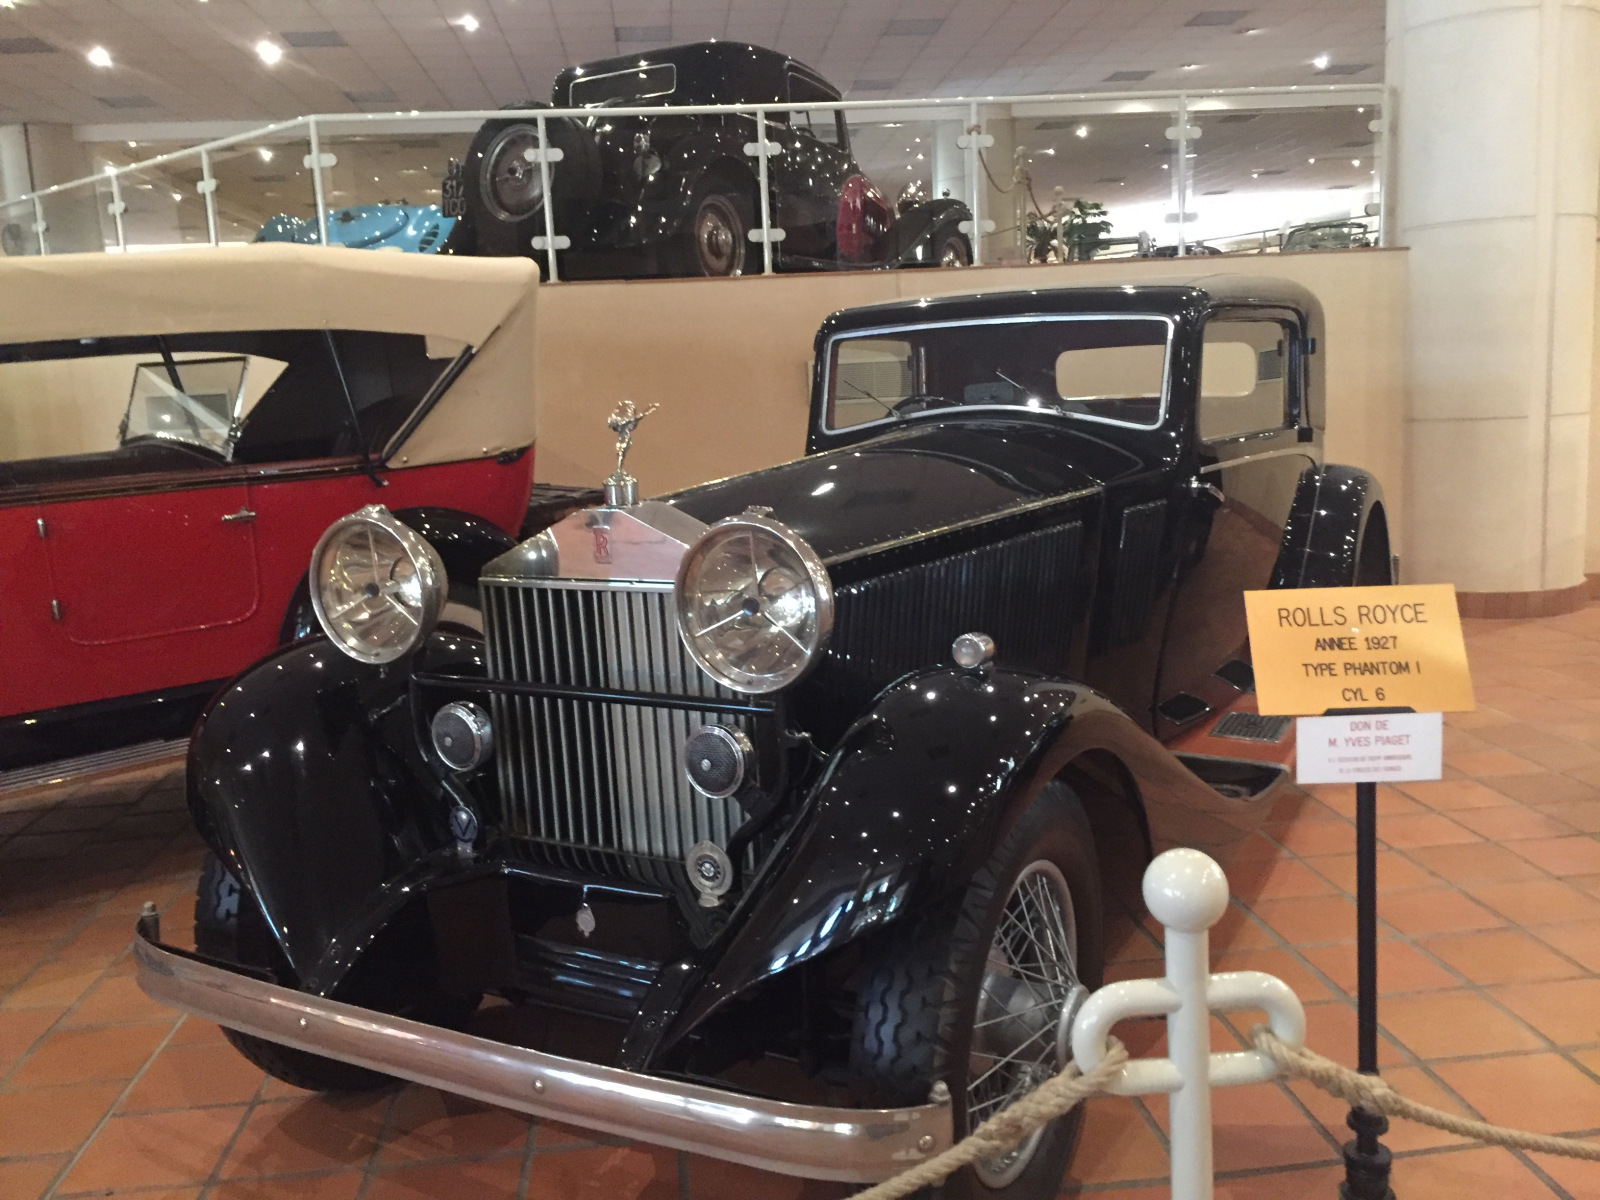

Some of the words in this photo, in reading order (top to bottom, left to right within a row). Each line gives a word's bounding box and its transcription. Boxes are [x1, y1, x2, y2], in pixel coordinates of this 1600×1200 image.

[1277, 606, 1347, 628] ROLLS
[1357, 603, 1428, 625] ROYCE
[1314, 637, 1358, 651] ANNEE
[1365, 636, 1398, 650] 1927
[1302, 663, 1338, 677] TYPE
[1343, 661, 1411, 677] PHANTOM
[1416, 661, 1421, 674] I
[1342, 688, 1369, 702] CYL
[1375, 687, 1386, 701] 6
[1350, 721, 1371, 732] DON
[1375, 720, 1389, 731] DE
[1345, 736, 1371, 747] YVES
[1374, 734, 1411, 746] PIAGET
